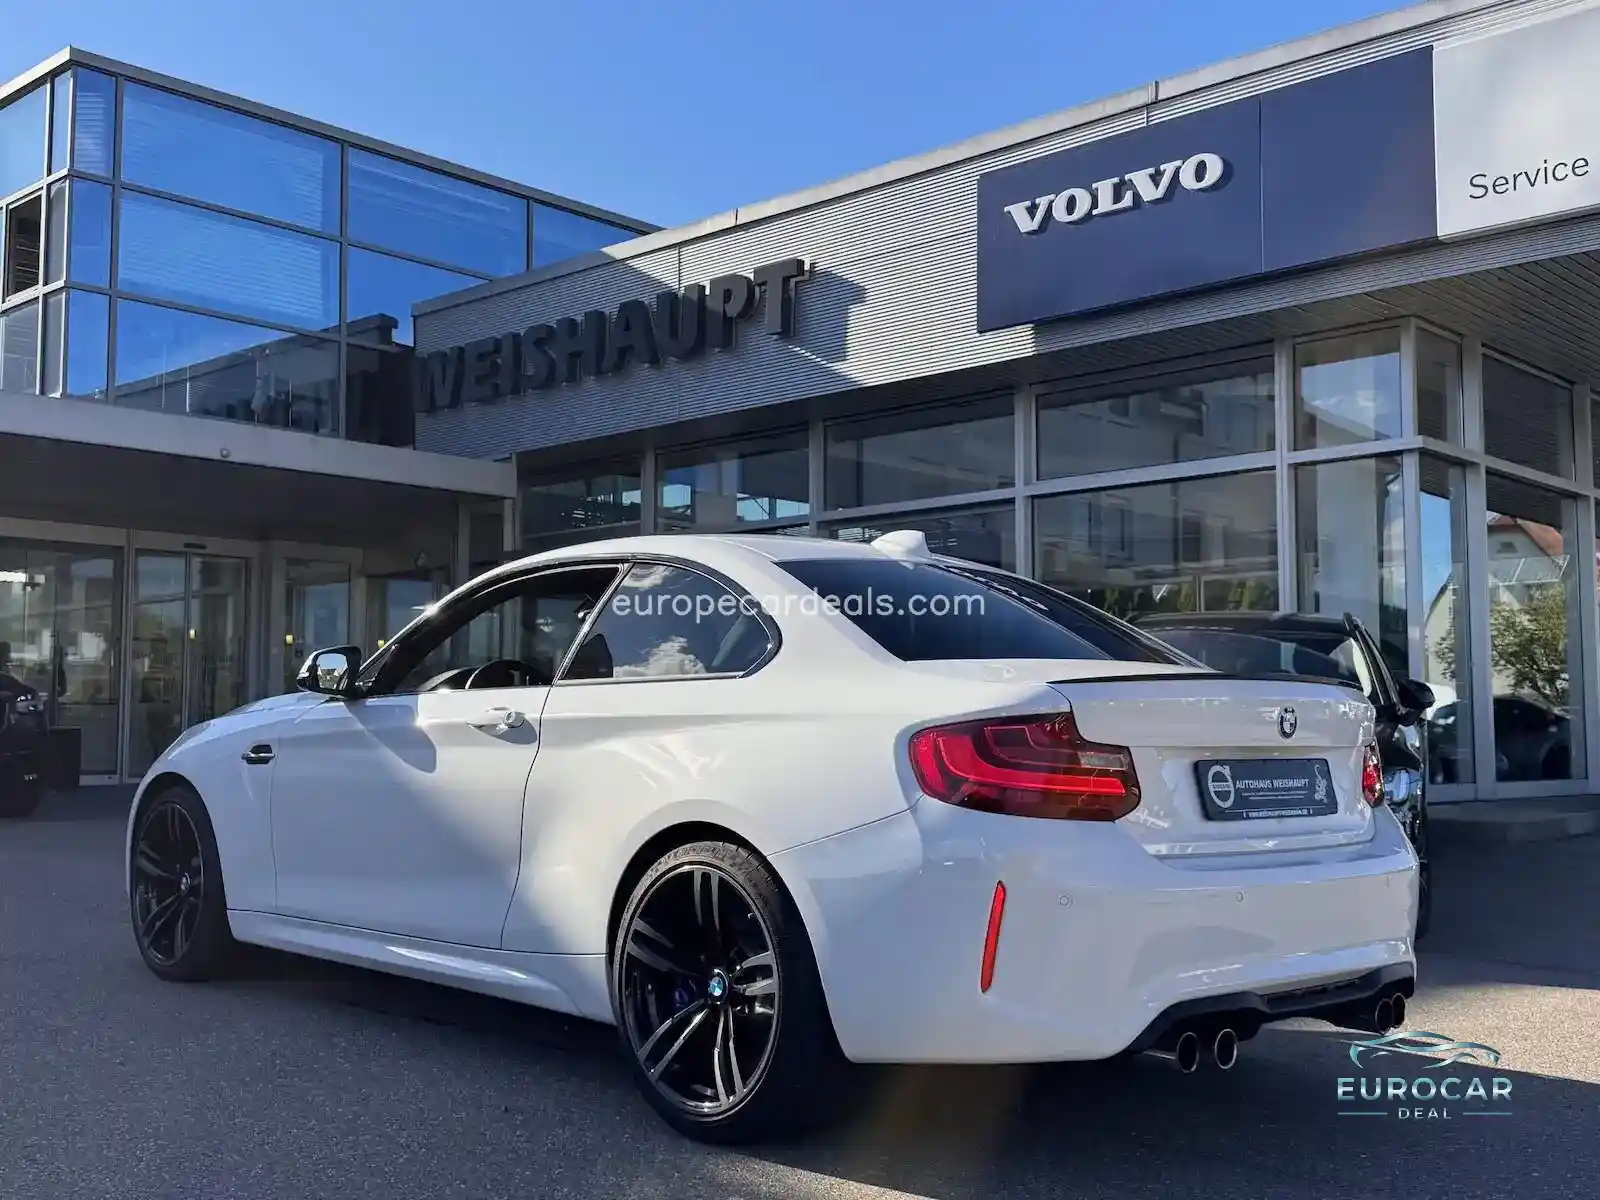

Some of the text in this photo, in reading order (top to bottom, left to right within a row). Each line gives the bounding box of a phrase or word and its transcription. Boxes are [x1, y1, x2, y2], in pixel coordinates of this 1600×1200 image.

[1004, 152, 1224, 234] VOLVO
[1468, 157, 1589, 199] Service
[413, 257, 810, 414] WEISHAUPT
[1235, 779, 1272, 789] AUTOHAUS
